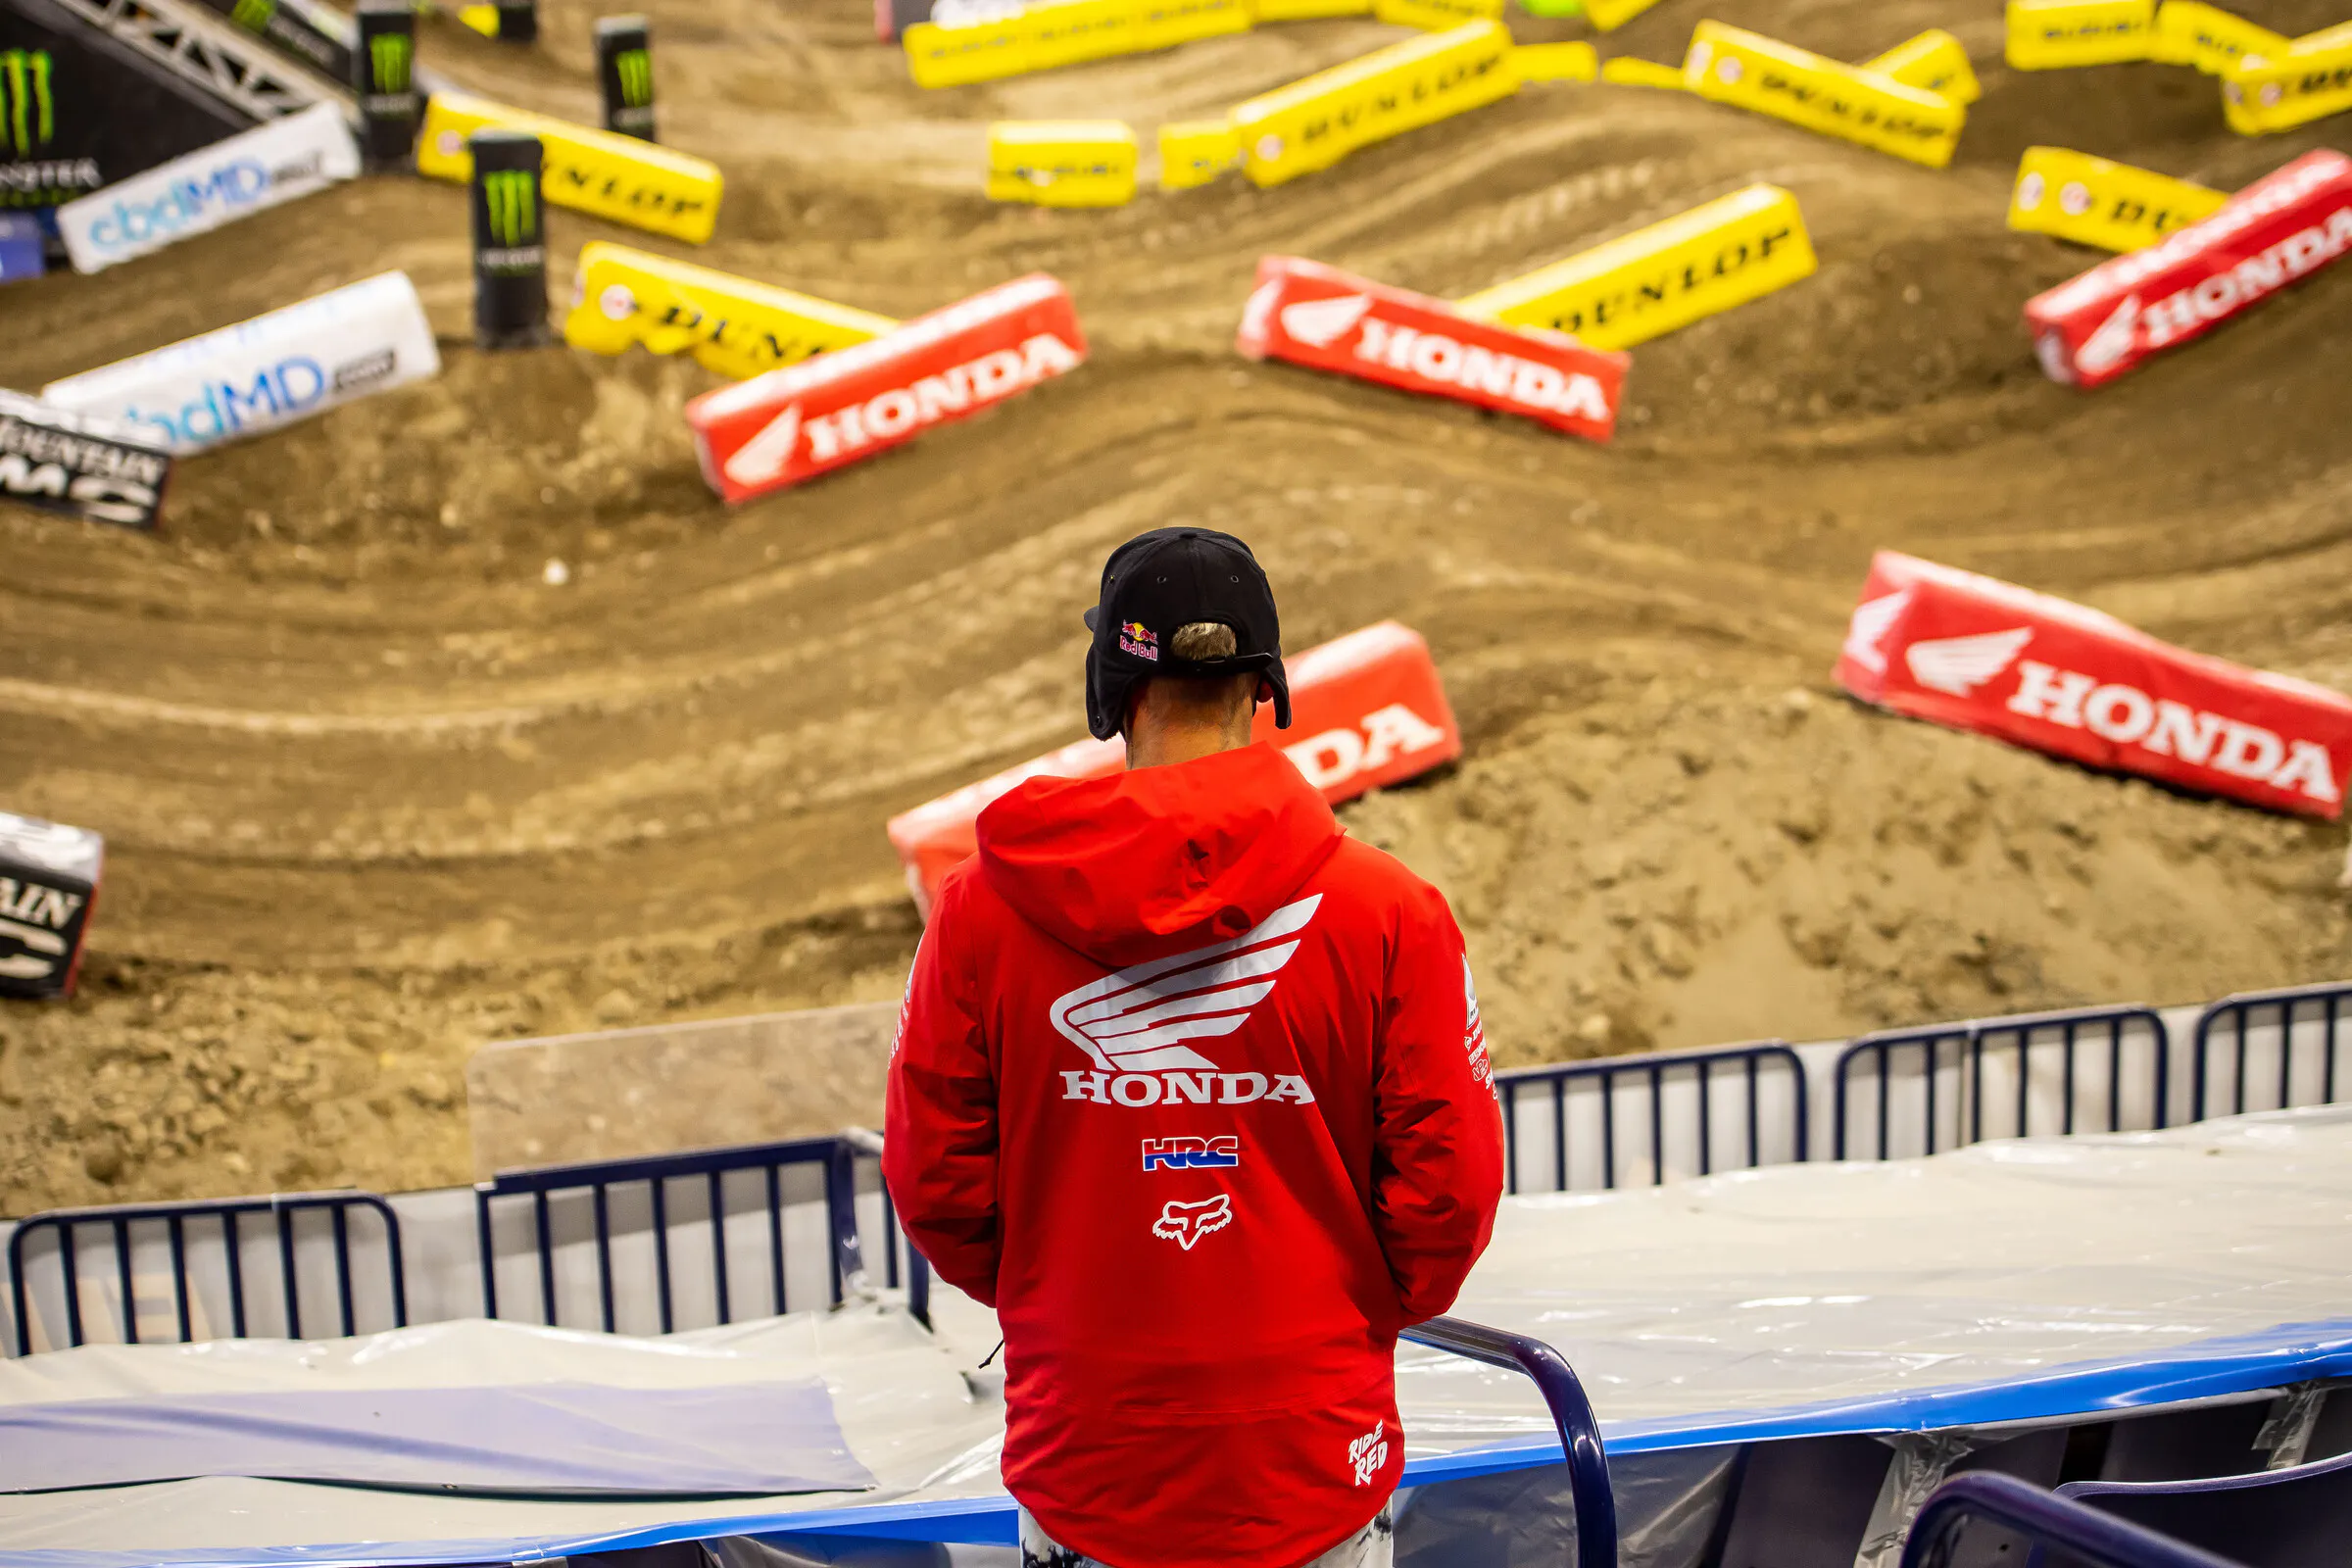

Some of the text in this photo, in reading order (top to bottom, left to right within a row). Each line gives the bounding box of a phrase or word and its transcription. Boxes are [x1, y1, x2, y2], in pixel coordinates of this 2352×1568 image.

[1352, 317, 1612, 423] HONDA
[803, 332, 1082, 463] HONDA
[1119, 634, 1158, 662] Red Bull
[2006, 658, 2343, 805] HONDA
[1059, 1070, 1315, 1107] HONDA
[1142, 1135, 1239, 1172] HRC
[1348, 1418, 1384, 1465] RIDE
[1354, 1441, 1389, 1487] RED
